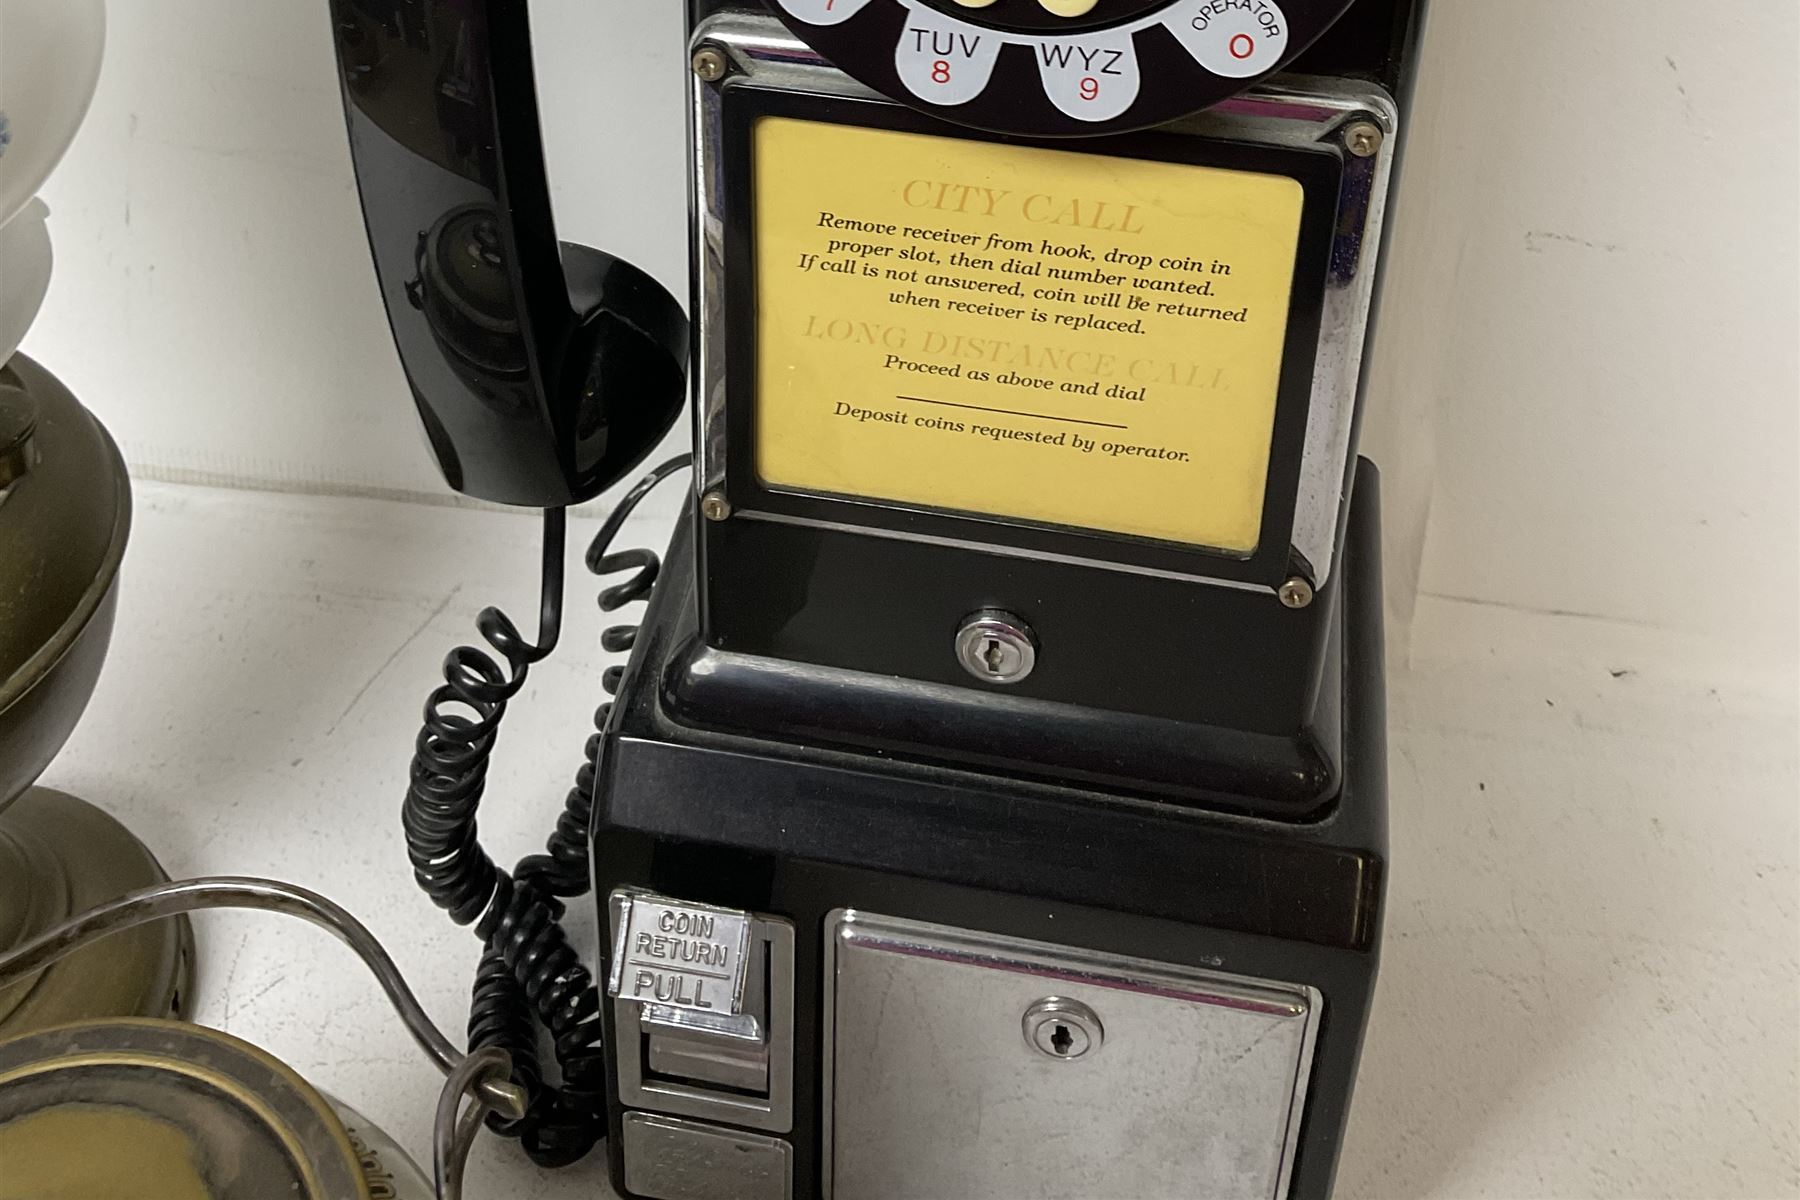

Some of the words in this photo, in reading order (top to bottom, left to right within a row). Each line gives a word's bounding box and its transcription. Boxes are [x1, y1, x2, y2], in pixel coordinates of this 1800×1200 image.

[910, 28, 980, 58] TUV
[1041, 43, 1123, 75] WYZ
[932, 60, 950, 83] 8
[1079, 77, 1099, 100] 9
[902, 179, 1012, 217] CITY
[1022, 194, 1144, 235] CALL
[816, 212, 897, 236] Remove
[902, 225, 982, 246] receiver
[984, 233, 1034, 253] from
[1040, 240, 1095, 262] hook,
[1104, 248, 1152, 270] drop
[1159, 257, 1203, 272] coin
[1210, 260, 1231, 276] in
[797, 253, 819, 272] If
[819, 259, 857, 275] call
[862, 263, 879, 278] is
[885, 267, 919, 283] not
[925, 272, 1026, 298] answered,
[1033, 287, 1076, 303] coin
[1083, 293, 1121, 308] will
[1127, 295, 1150, 311] be
[1156, 302, 1249, 323] returned
[827, 239, 894, 258] proper
[898, 246, 941, 265] slot,
[949, 252, 994, 270] then
[1000, 258, 1042, 276] dial
[1047, 267, 1126, 287] number
[1132, 277, 1215, 297] wanted.
[888, 291, 941, 309] when
[947, 300, 1026, 320] receiver
[1031, 308, 1048, 322] is
[1054, 312, 1146, 335] replaced.
[801, 315, 908, 349] LONG
[921, 330, 1117, 377] DISTANCE
[1128, 359, 1231, 391] CALL
[883, 354, 962, 378] Proceed
[967, 369, 990, 382] as
[996, 371, 1054, 390] above
[1060, 382, 1099, 396] and
[1105, 385, 1146, 401] dial
[833, 402, 909, 425] Deposit
[914, 415, 965, 432] coins
[971, 425, 1066, 446] requested
[1072, 434, 1096, 452] by
[1101, 442, 1190, 462] operator.
[658, 910, 714, 939] COIN
[635, 932, 728, 968] RETURN
[634, 970, 712, 1008] PULL
